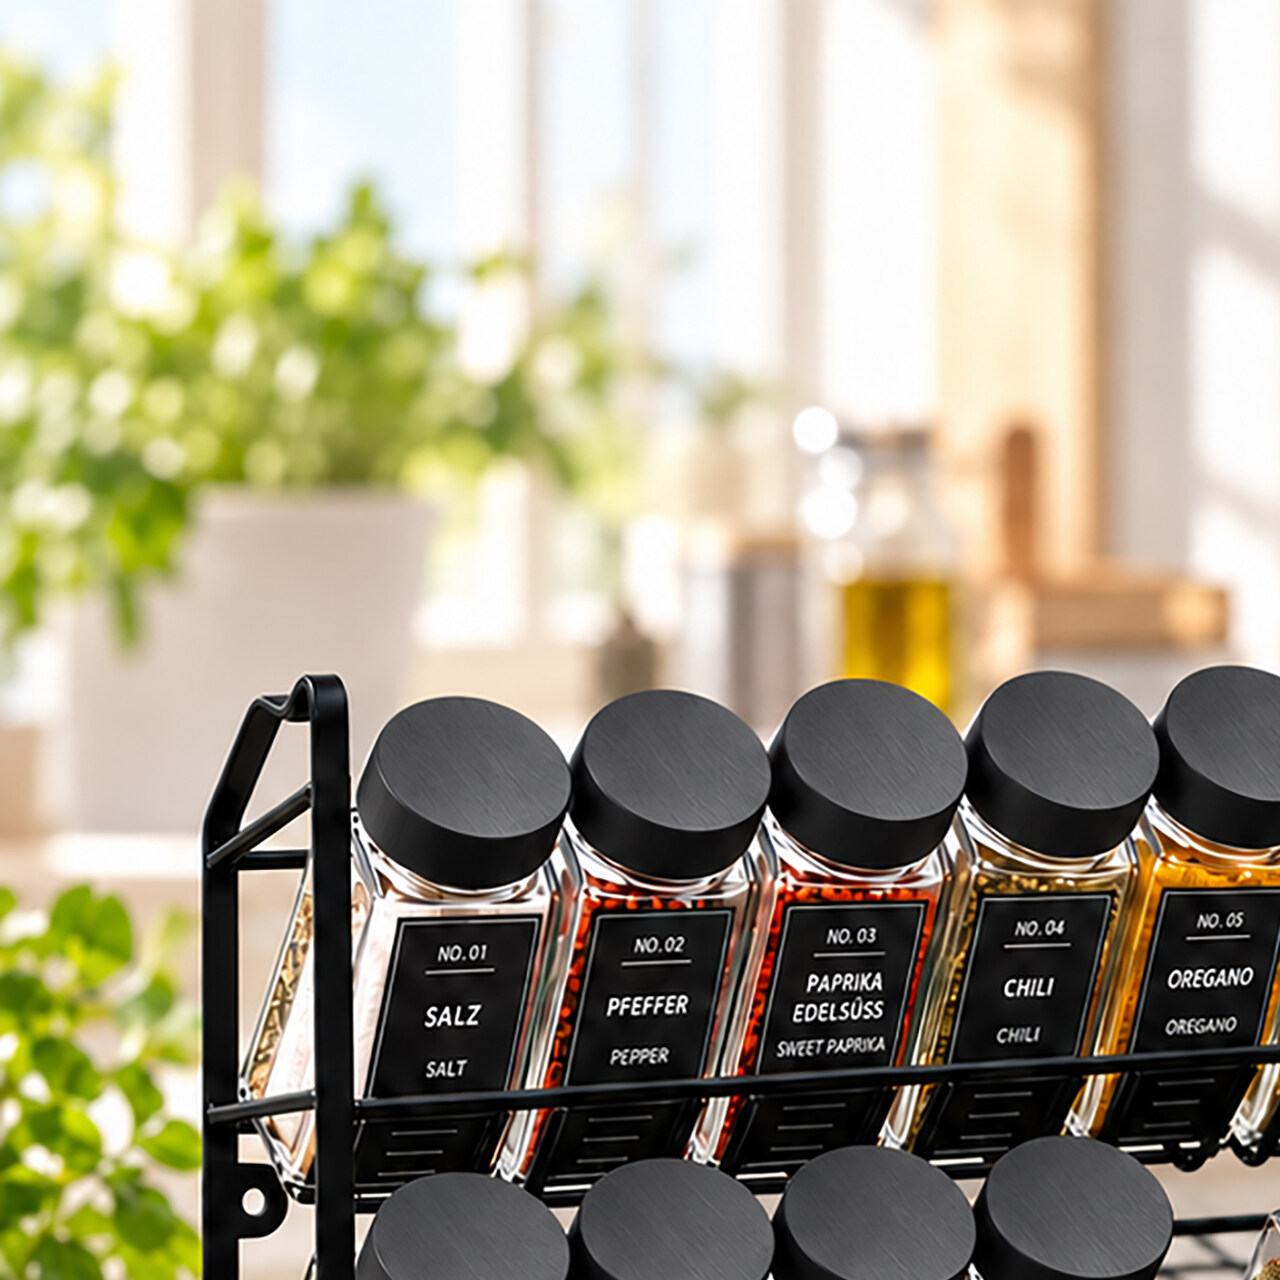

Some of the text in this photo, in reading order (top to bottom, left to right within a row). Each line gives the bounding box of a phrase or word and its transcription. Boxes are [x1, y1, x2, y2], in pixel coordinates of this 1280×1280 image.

[1015, 920, 1064, 936] NO. 04
[1197, 912, 1243, 928] NO. 05
[634, 937, 684, 953] NO. 02
[827, 928, 876, 944] NO. 03
[438, 945, 486, 961] NO. 01
[807, 972, 882, 992] PAPRIKA
[1168, 967, 1253, 989] OREGANO
[1004, 978, 1054, 997] CHILI
[607, 995, 688, 1016] PFEFFER
[793, 997, 884, 1022] EDELSÜSS
[425, 1005, 481, 1027] SALZ
[997, 1027, 1040, 1043] CHILI
[1166, 1017, 1237, 1035] OREGANO
[610, 1047, 669, 1065] PEPPER
[777, 1037, 885, 1057] SWEET PAPRIKA
[426, 1060, 467, 1078] SALT
